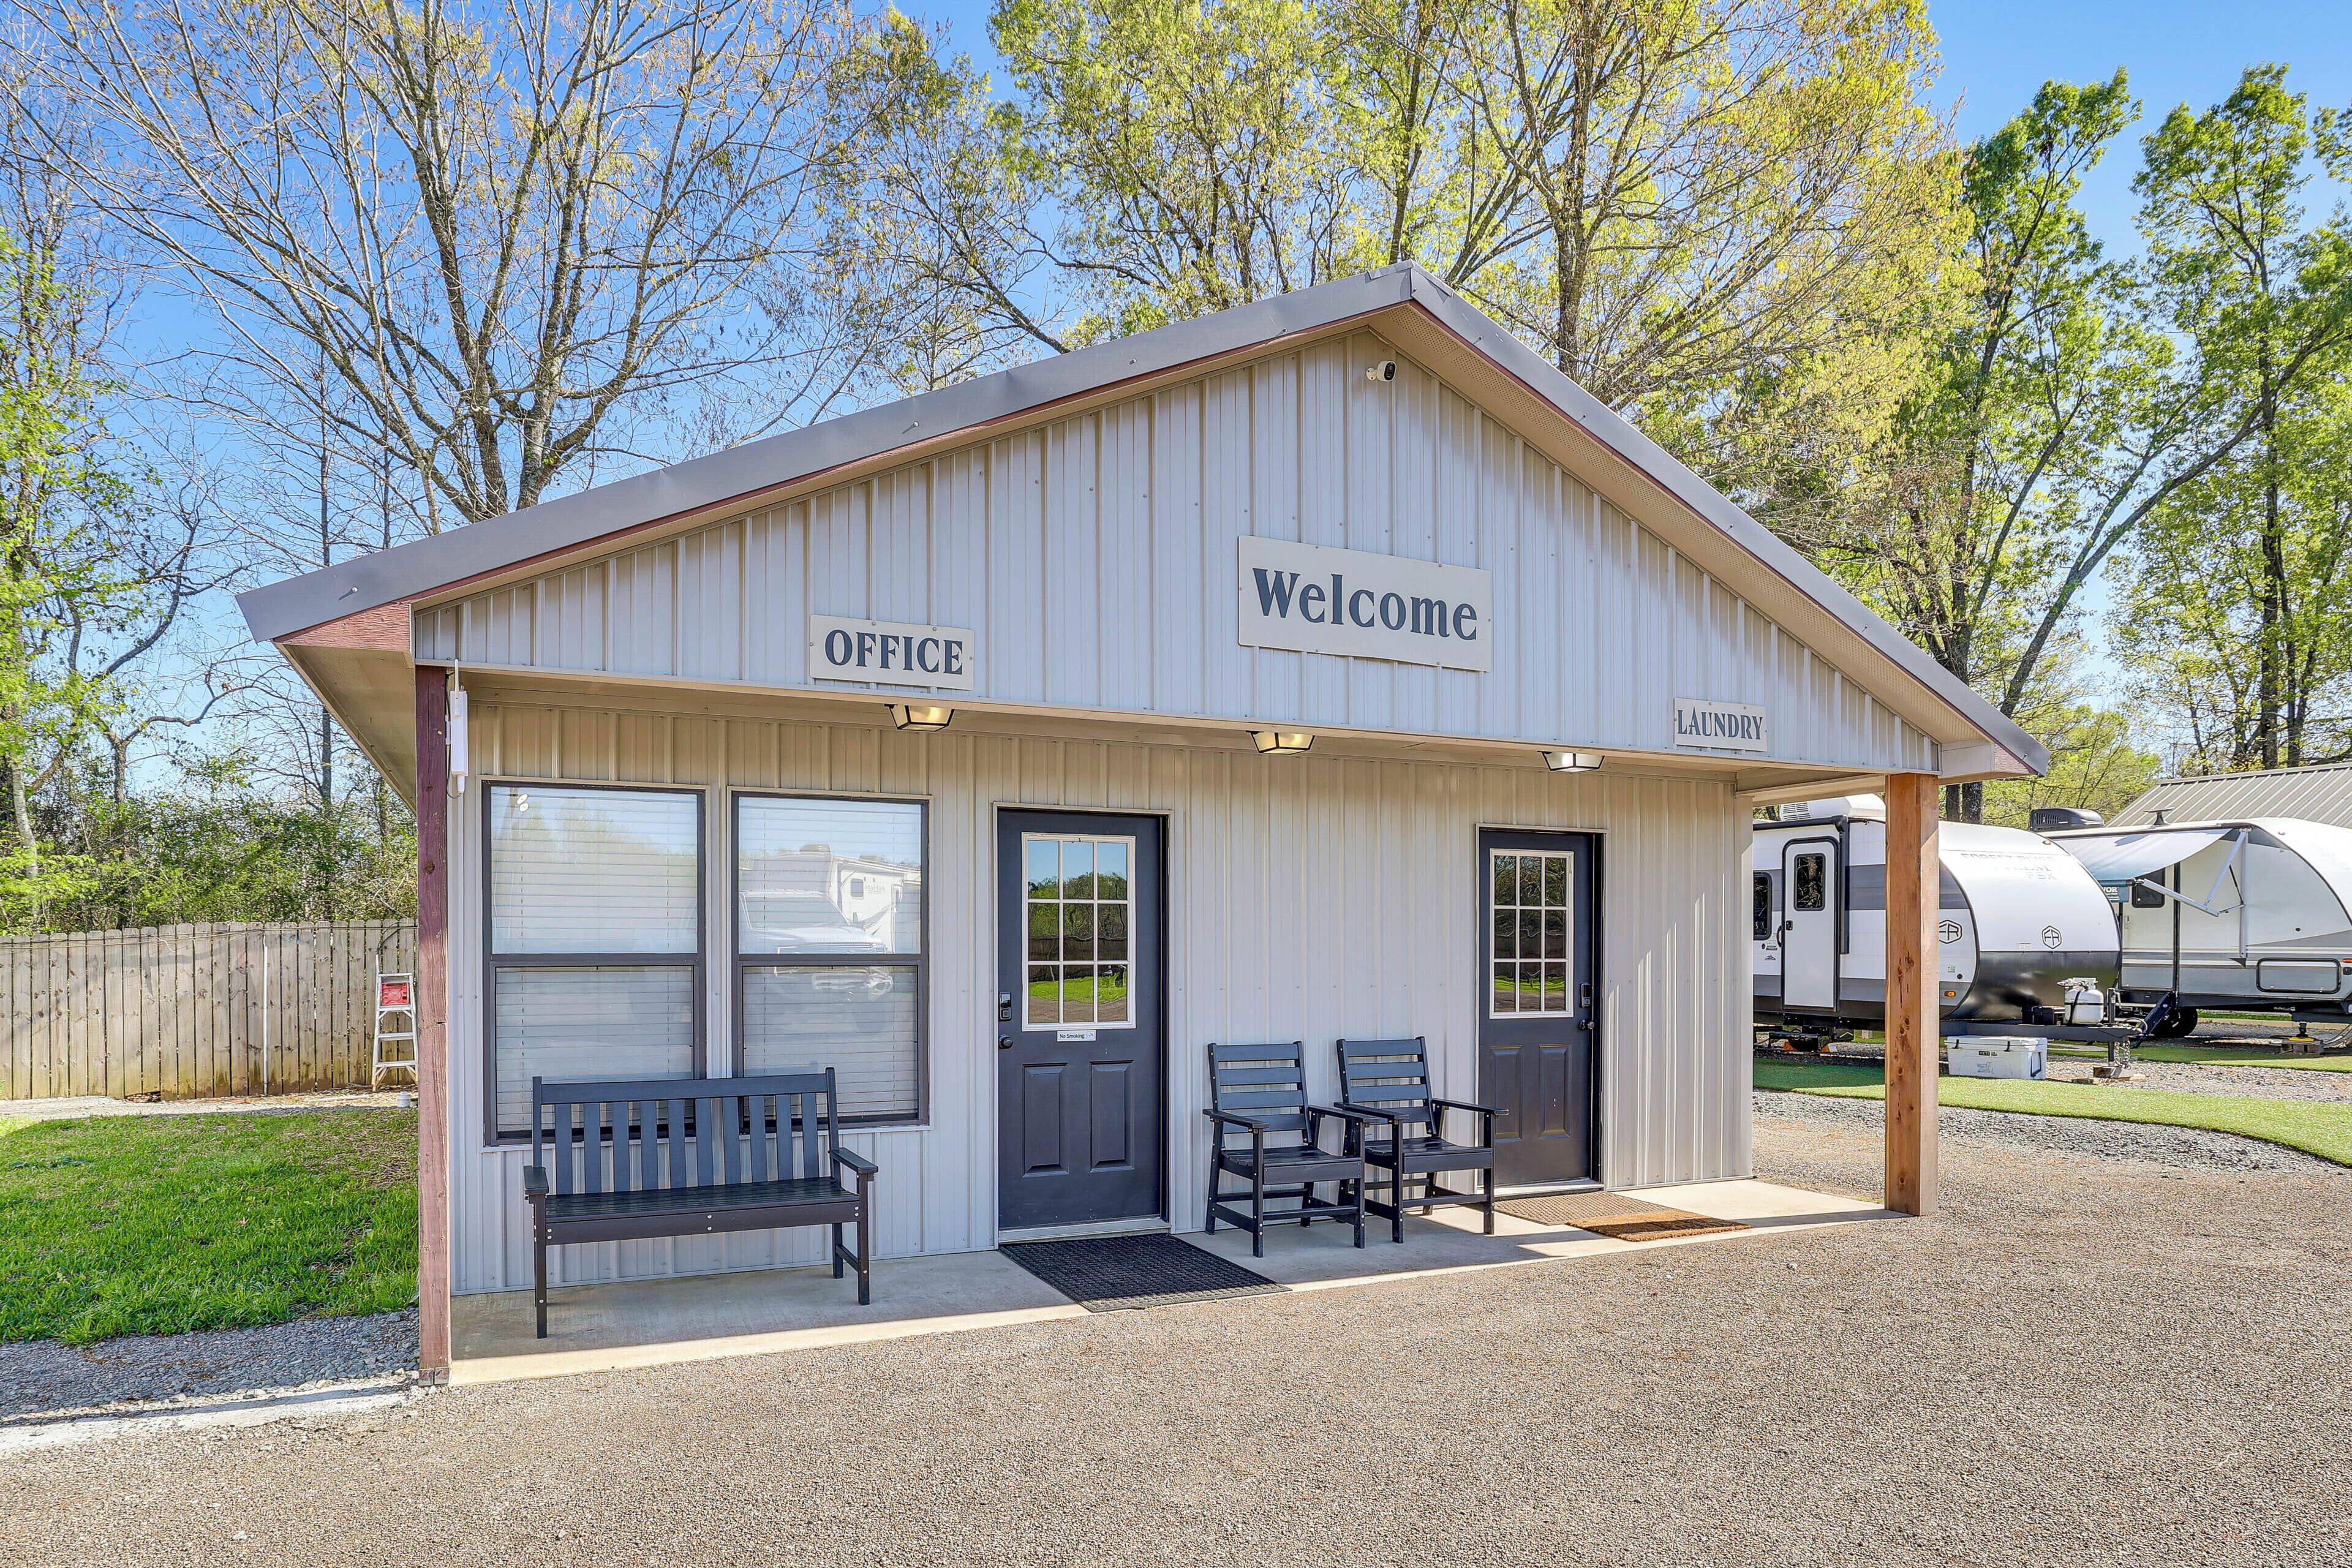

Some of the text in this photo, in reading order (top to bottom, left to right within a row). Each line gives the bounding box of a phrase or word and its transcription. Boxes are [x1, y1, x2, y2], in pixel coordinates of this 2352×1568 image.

[1252, 567, 1477, 641] Welcome
[825, 629, 963, 675] OFFICE
[1677, 706, 1763, 740] LAUNDRY
